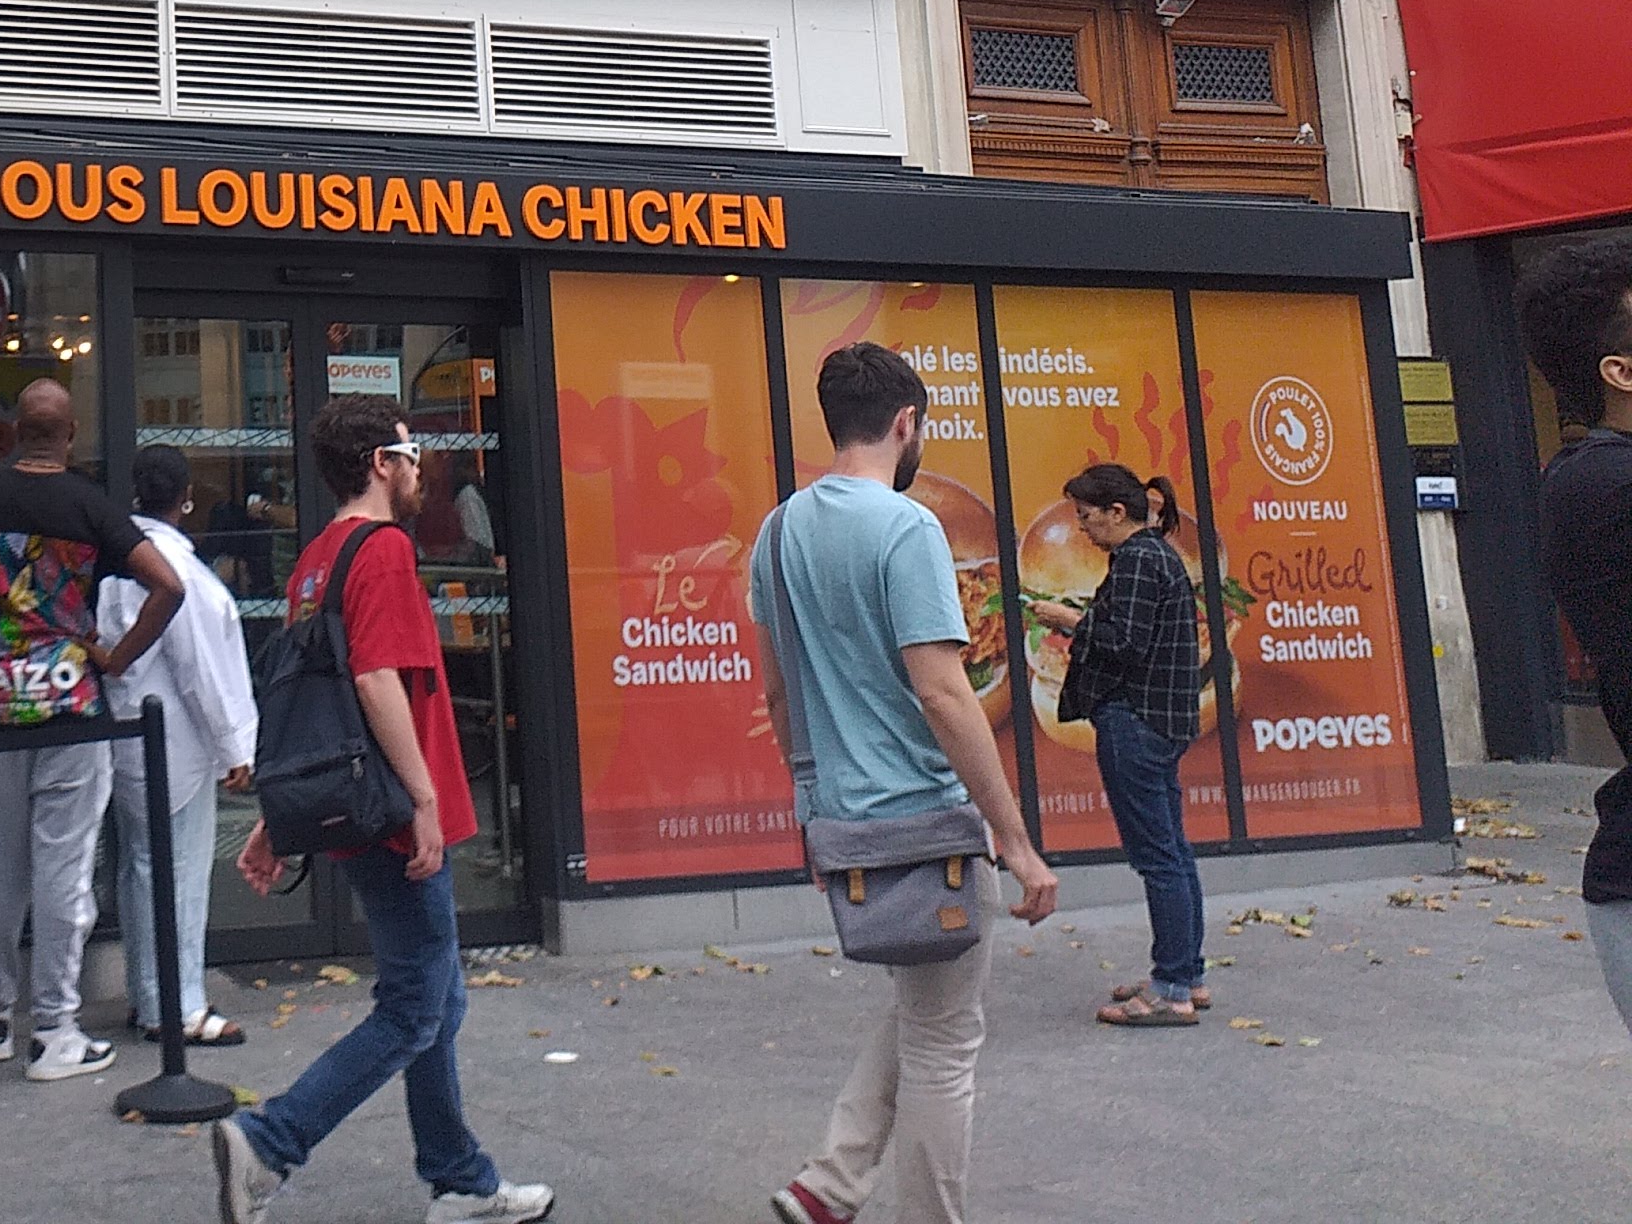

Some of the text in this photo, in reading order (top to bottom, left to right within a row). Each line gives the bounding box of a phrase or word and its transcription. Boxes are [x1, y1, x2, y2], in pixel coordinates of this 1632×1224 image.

[161, 167, 513, 238] LOUISIANA
[522, 184, 787, 249] CHICKEN
[901, 345, 1094, 374] olé les indécis.
[1002, 386, 1061, 407] vous
[1065, 387, 1120, 407] avez
[921, 412, 985, 440] hoix.
[1264, 386, 1326, 474] POULET 100% FRANÇAIS
[1253, 500, 1348, 521] NOUVEAU
[653, 555, 708, 616] Le
[1247, 546, 1372, 600] Grilled
[1266, 600, 1360, 628] Chicken
[622, 615, 738, 648] Chicken
[1259, 631, 1372, 662] Sandwich
[612, 651, 752, 687] Sandwich
[659, 810, 801, 839] POUR VOTRE SANT
